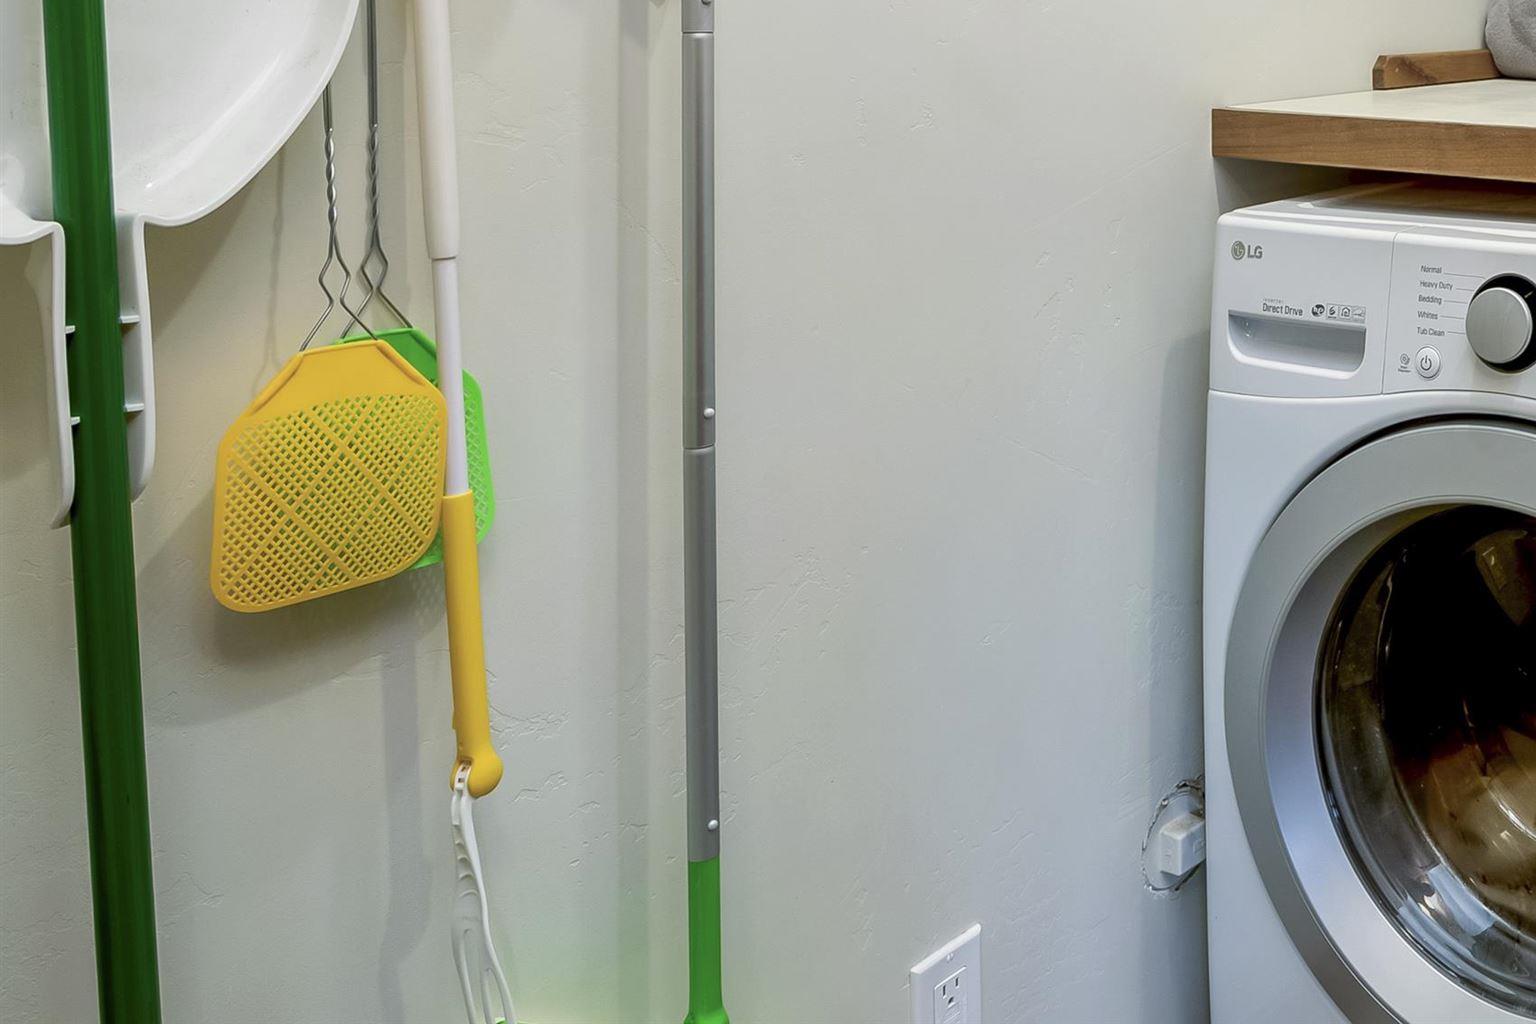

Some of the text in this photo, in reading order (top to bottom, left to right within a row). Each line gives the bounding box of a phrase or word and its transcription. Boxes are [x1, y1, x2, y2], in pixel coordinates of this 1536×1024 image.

[1247, 245, 1263, 259] LG
[1420, 265, 1442, 274] Normal
[1420, 281, 1454, 291] Heavy Duty
[1418, 294, 1442, 305] Bedding
[1263, 303, 1304, 317] Direct Drive
[1417, 311, 1438, 320] Whites
[1417, 327, 1445, 336] Tub Clean
